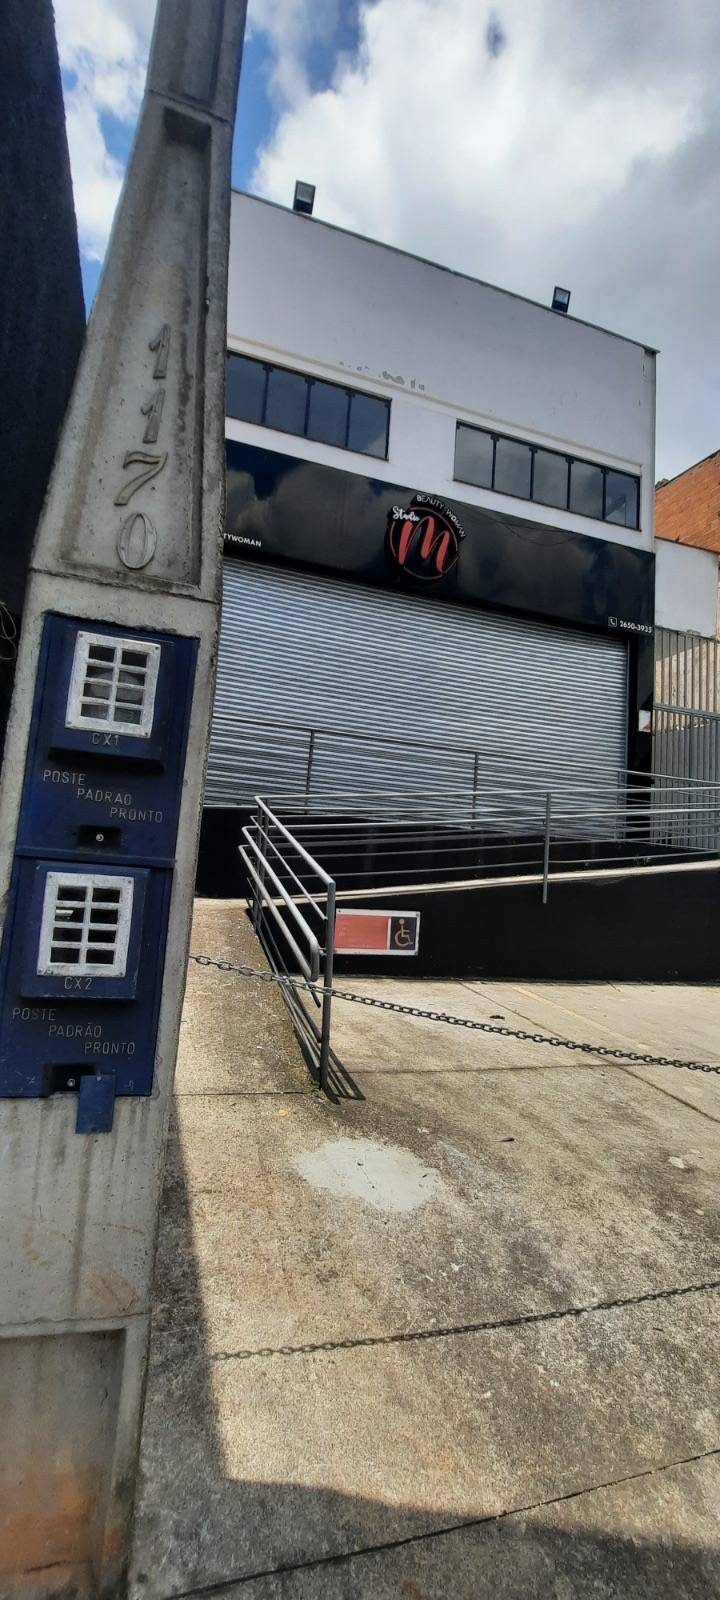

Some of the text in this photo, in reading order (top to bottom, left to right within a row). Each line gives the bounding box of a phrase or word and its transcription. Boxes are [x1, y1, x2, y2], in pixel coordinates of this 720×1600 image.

[113, 323, 172, 569] 1170
[416, 494, 466, 537] BEAUTY WOMAN
[92, 732, 119, 746] CX1
[43, 769, 86, 786] POSTE
[109, 807, 163, 823] PRONTO
[63, 976, 93, 990] CX2
[12, 1006, 57, 1021] POSTE
[49, 1022, 102, 1038] PADRÃO
[84, 1041, 135, 1056] PRONTO
